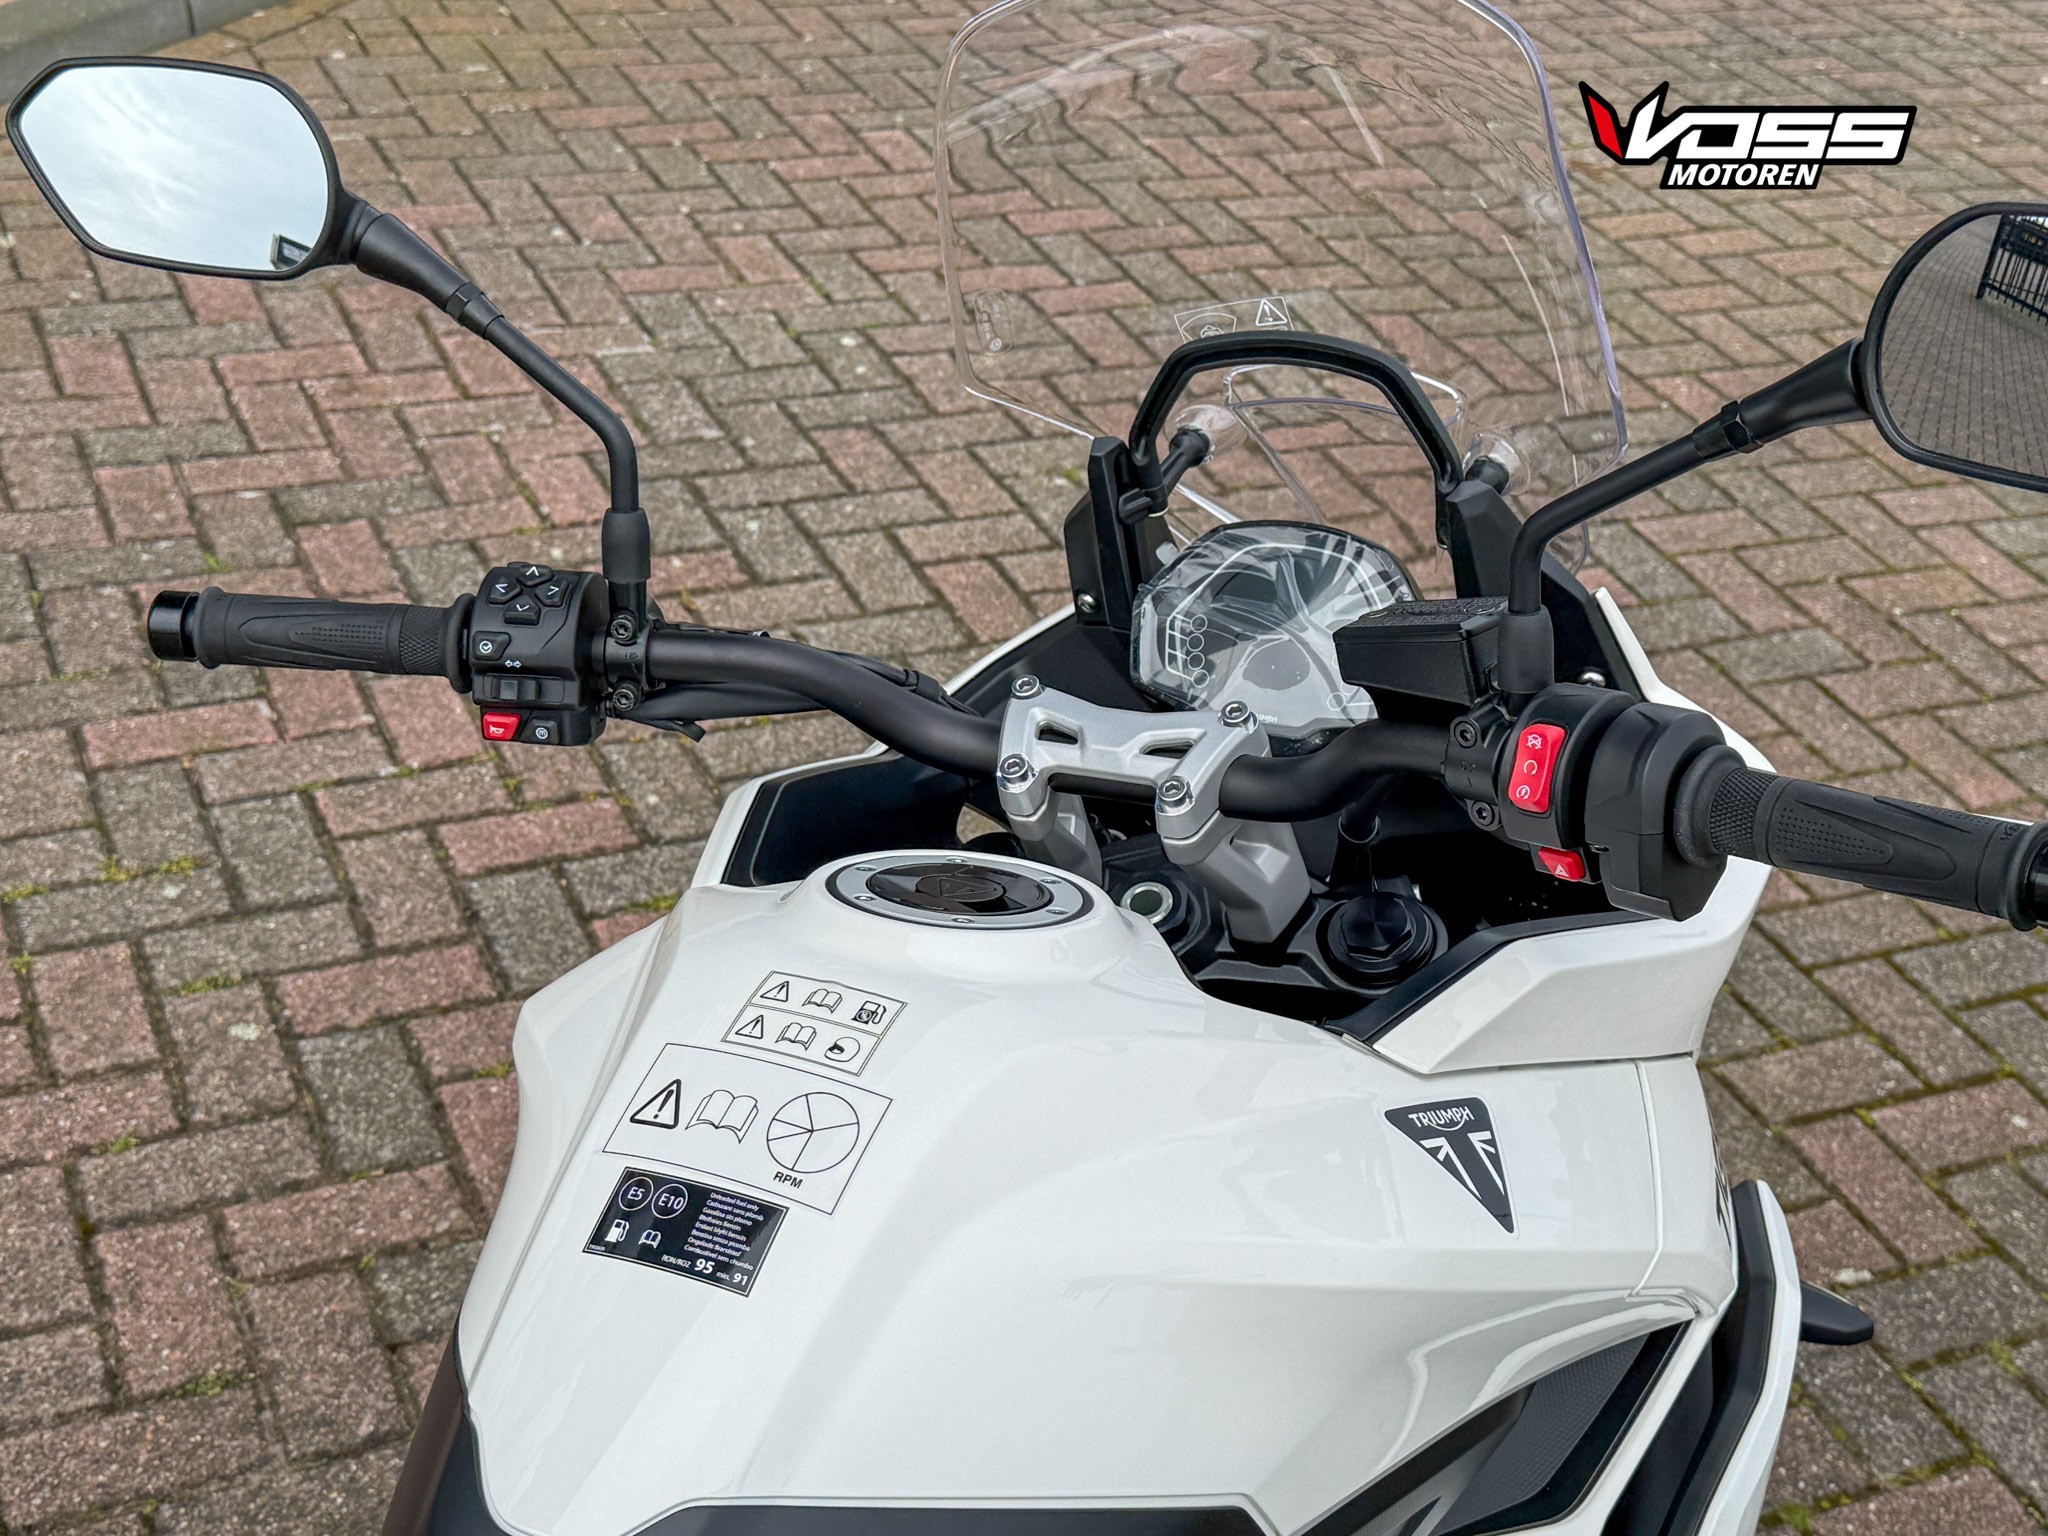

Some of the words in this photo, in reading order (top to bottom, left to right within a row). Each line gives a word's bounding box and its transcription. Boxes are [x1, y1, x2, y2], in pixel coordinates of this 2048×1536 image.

[1408, 1106, 1475, 1130] TRIUMPH
[773, 1171, 804, 1189] RPM
[627, 1187, 645, 1201] E5
[658, 1193, 684, 1210] E10
[736, 1199, 747, 1207] fuel
[746, 1203, 760, 1211] only
[661, 1254, 692, 1268] RON/ROZ
[694, 1258, 716, 1274] 95
[716, 1271, 730, 1281] min.
[732, 1273, 749, 1286] 91
[729, 1258, 754, 1271] chumbo
